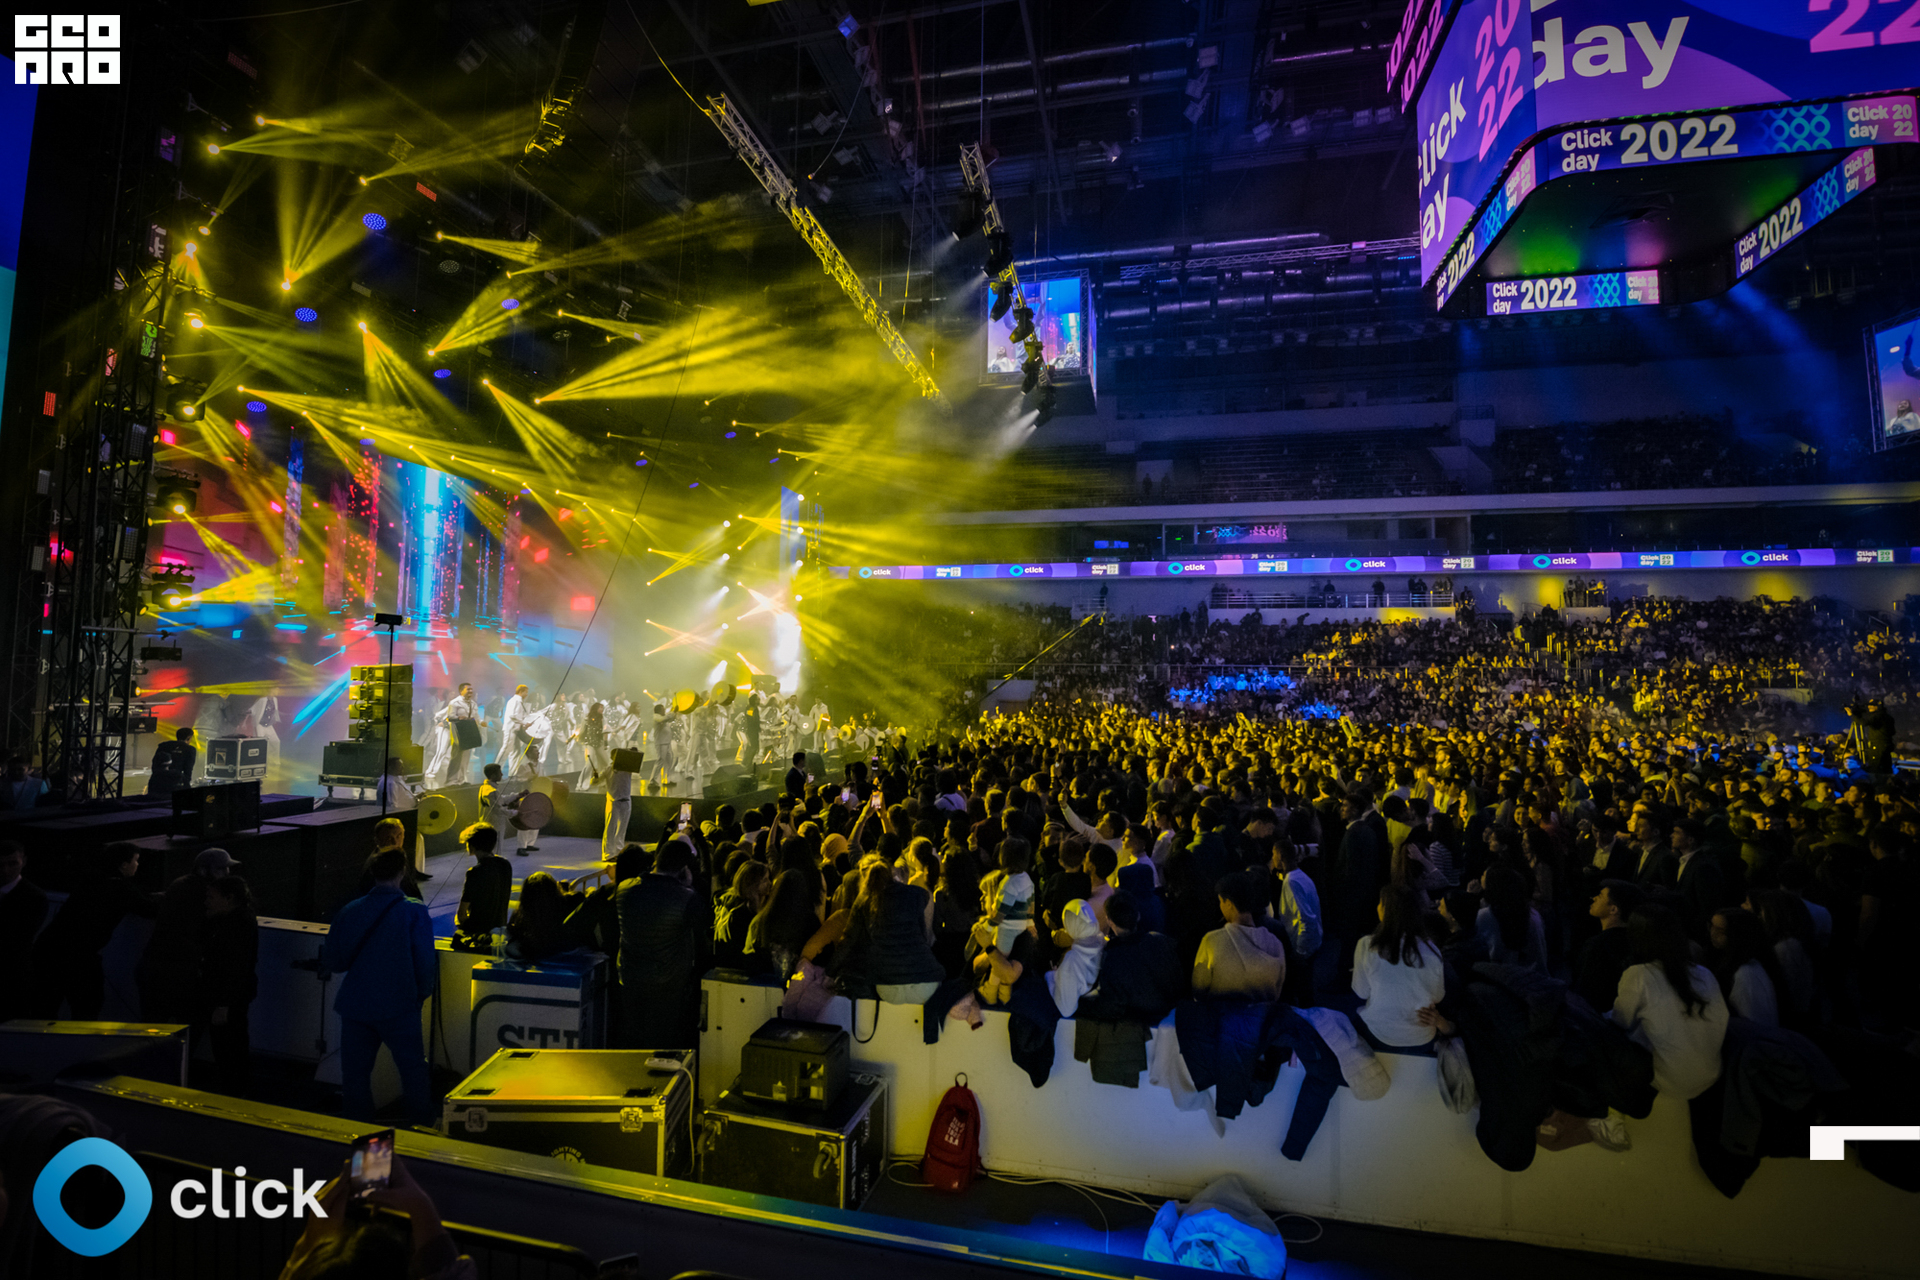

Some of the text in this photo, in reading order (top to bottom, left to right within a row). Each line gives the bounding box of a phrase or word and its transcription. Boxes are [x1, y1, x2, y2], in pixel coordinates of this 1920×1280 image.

[1478, 47, 1523, 163] 22
[1847, 104, 1912, 122] Click 20
[1418, 76, 1467, 198] lick
[1561, 128, 1613, 151] Click
[1620, 114, 1738, 164] 2022
[1849, 121, 1913, 140] day 22
[1562, 153, 1600, 172] day
[1420, 173, 1450, 250] ay
[1758, 197, 1803, 259] 2022
[1739, 232, 1757, 256] Click
[1740, 254, 1753, 274] day
[1492, 282, 1518, 298] Click
[1520, 276, 1577, 310] 2022
[1493, 299, 1511, 314] day
[1363, 560, 1386, 568] click
[1552, 557, 1577, 565] click
[1762, 553, 1789, 561] click
